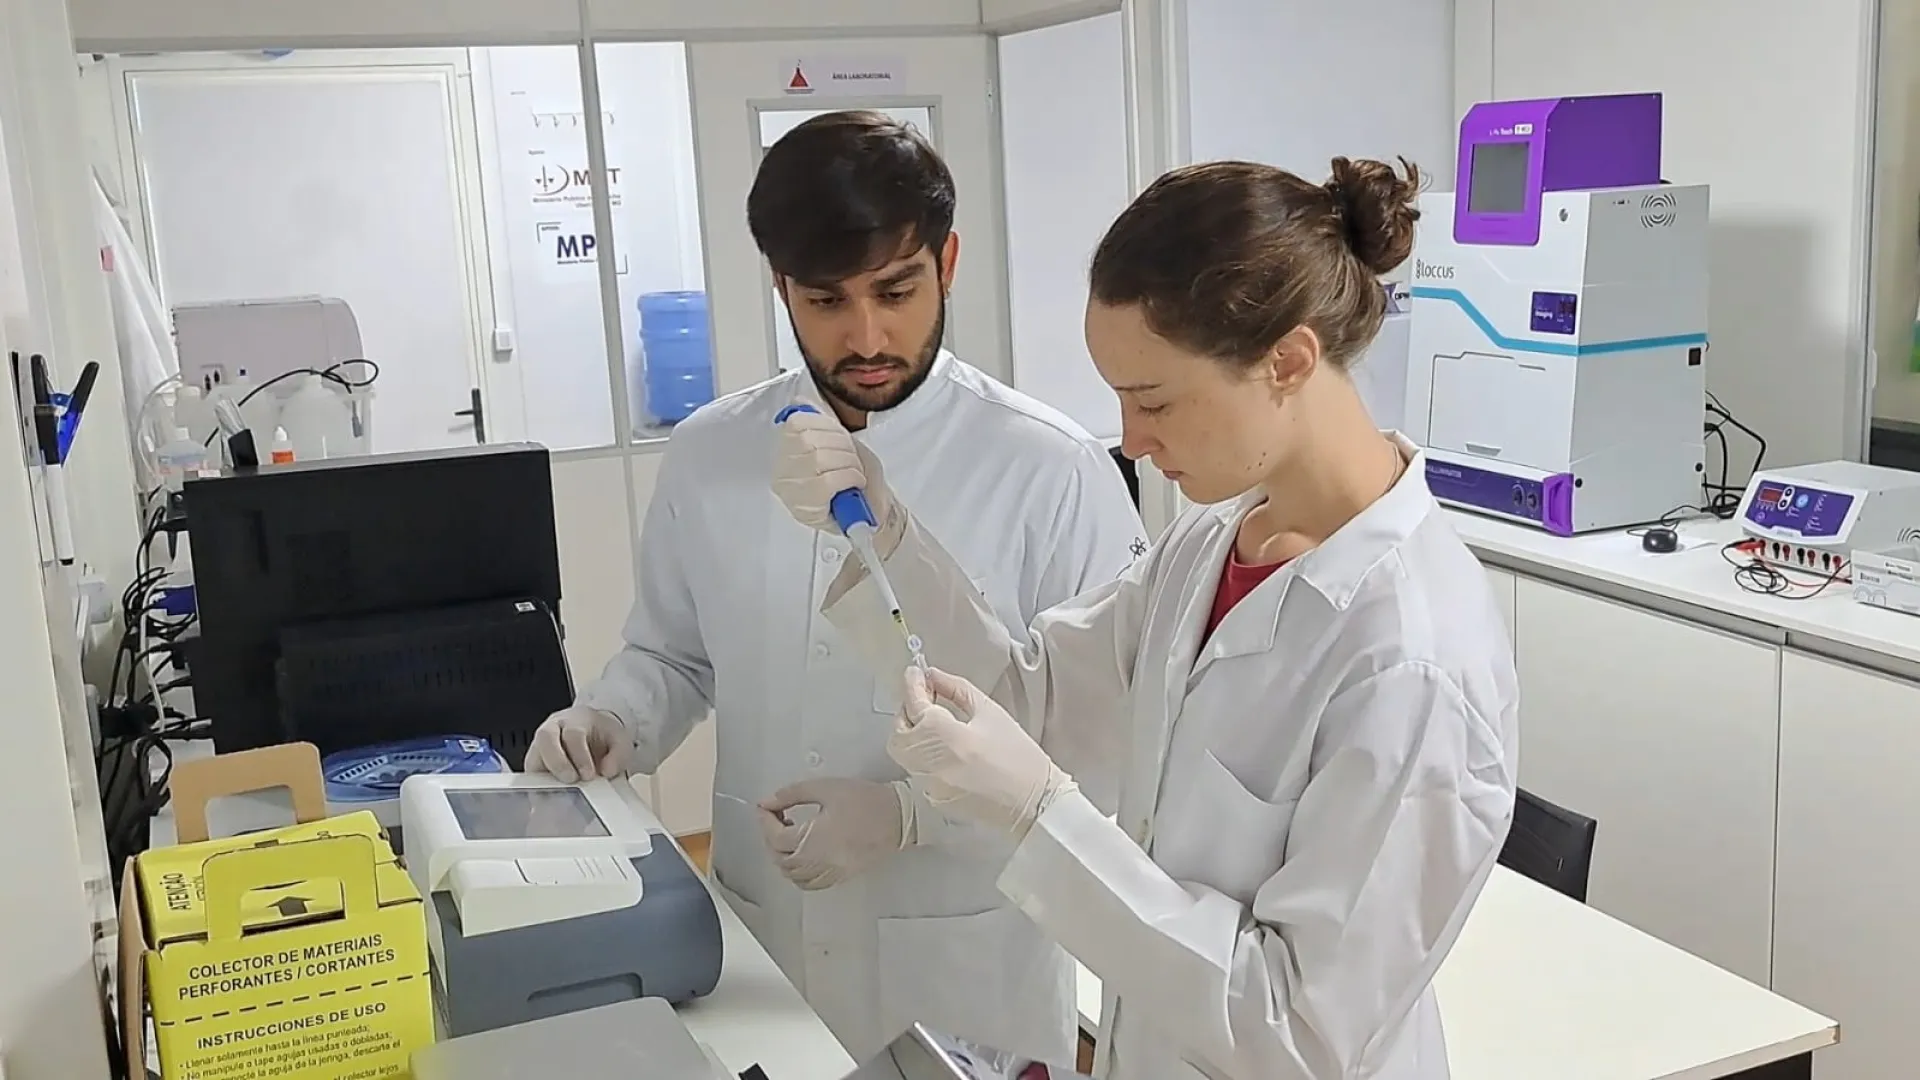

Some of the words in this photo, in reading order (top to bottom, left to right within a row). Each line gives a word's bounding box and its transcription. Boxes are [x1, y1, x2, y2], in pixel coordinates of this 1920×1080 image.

[573, 168, 621, 186] MT
[556, 233, 597, 258] MP
[160, 872, 191, 911] ATENÇÃO
[189, 954, 275, 980] COLECTOR
[278, 949, 299, 964] DE
[303, 934, 383, 961] MATERIAIS
[179, 967, 294, 1000] PERFORANTES
[305, 949, 395, 977] CORTANTES
[197, 1014, 325, 1049] INSTRUCCIONES
[329, 1008, 349, 1022] DE
[354, 1002, 386, 1018] USO
[217, 1046, 264, 1062] solamente
[265, 1039, 291, 1052] hasta
[292, 1037, 301, 1046] la
[254, 1055, 275, 1067] tape
[277, 1049, 306, 1062] agujas
[308, 1042, 340, 1055] usadas
